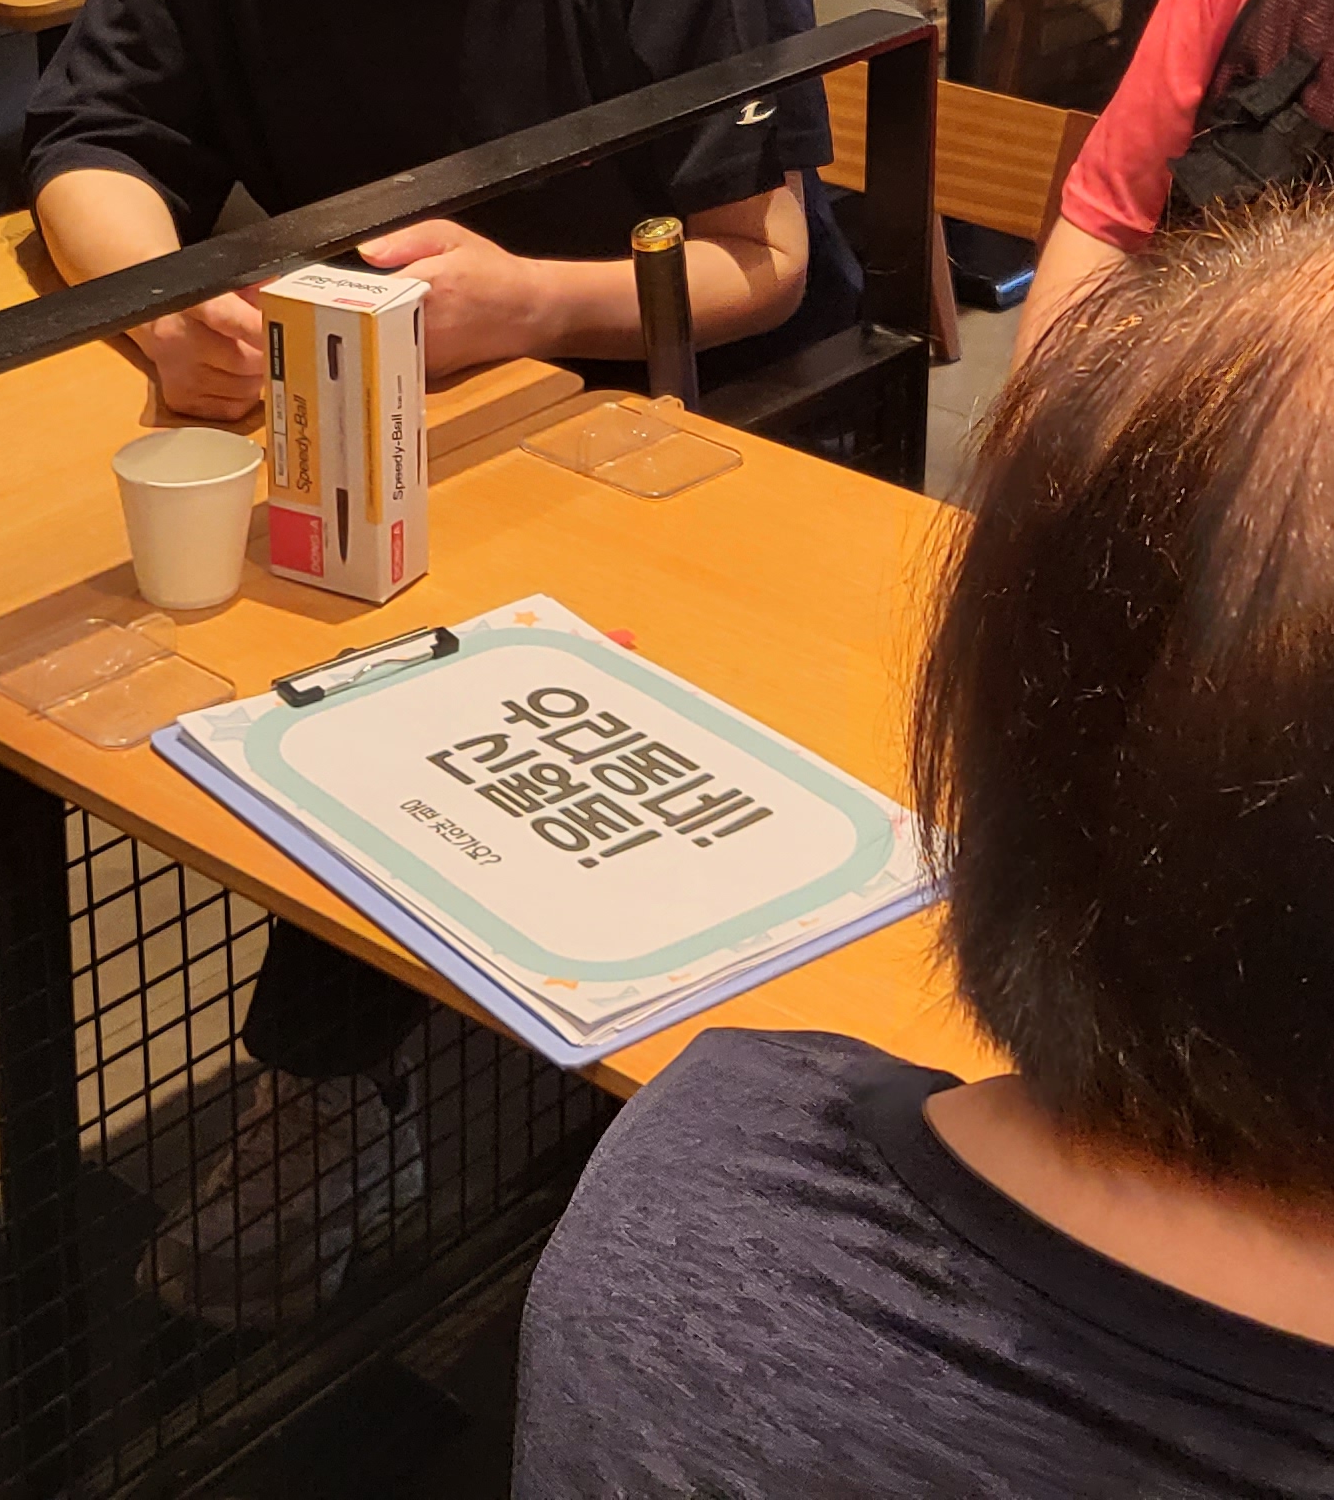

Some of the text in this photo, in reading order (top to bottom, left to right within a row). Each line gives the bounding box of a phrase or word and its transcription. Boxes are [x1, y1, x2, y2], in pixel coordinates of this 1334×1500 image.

[293, 394, 313, 493] Speedy-Ball
[392, 414, 406, 501] Speedy-Ball
[426, 732, 663, 869] 신월동!
[501, 687, 774, 848] 우리동네!
[400, 798, 502, 867] 어떤 곳인가요?
